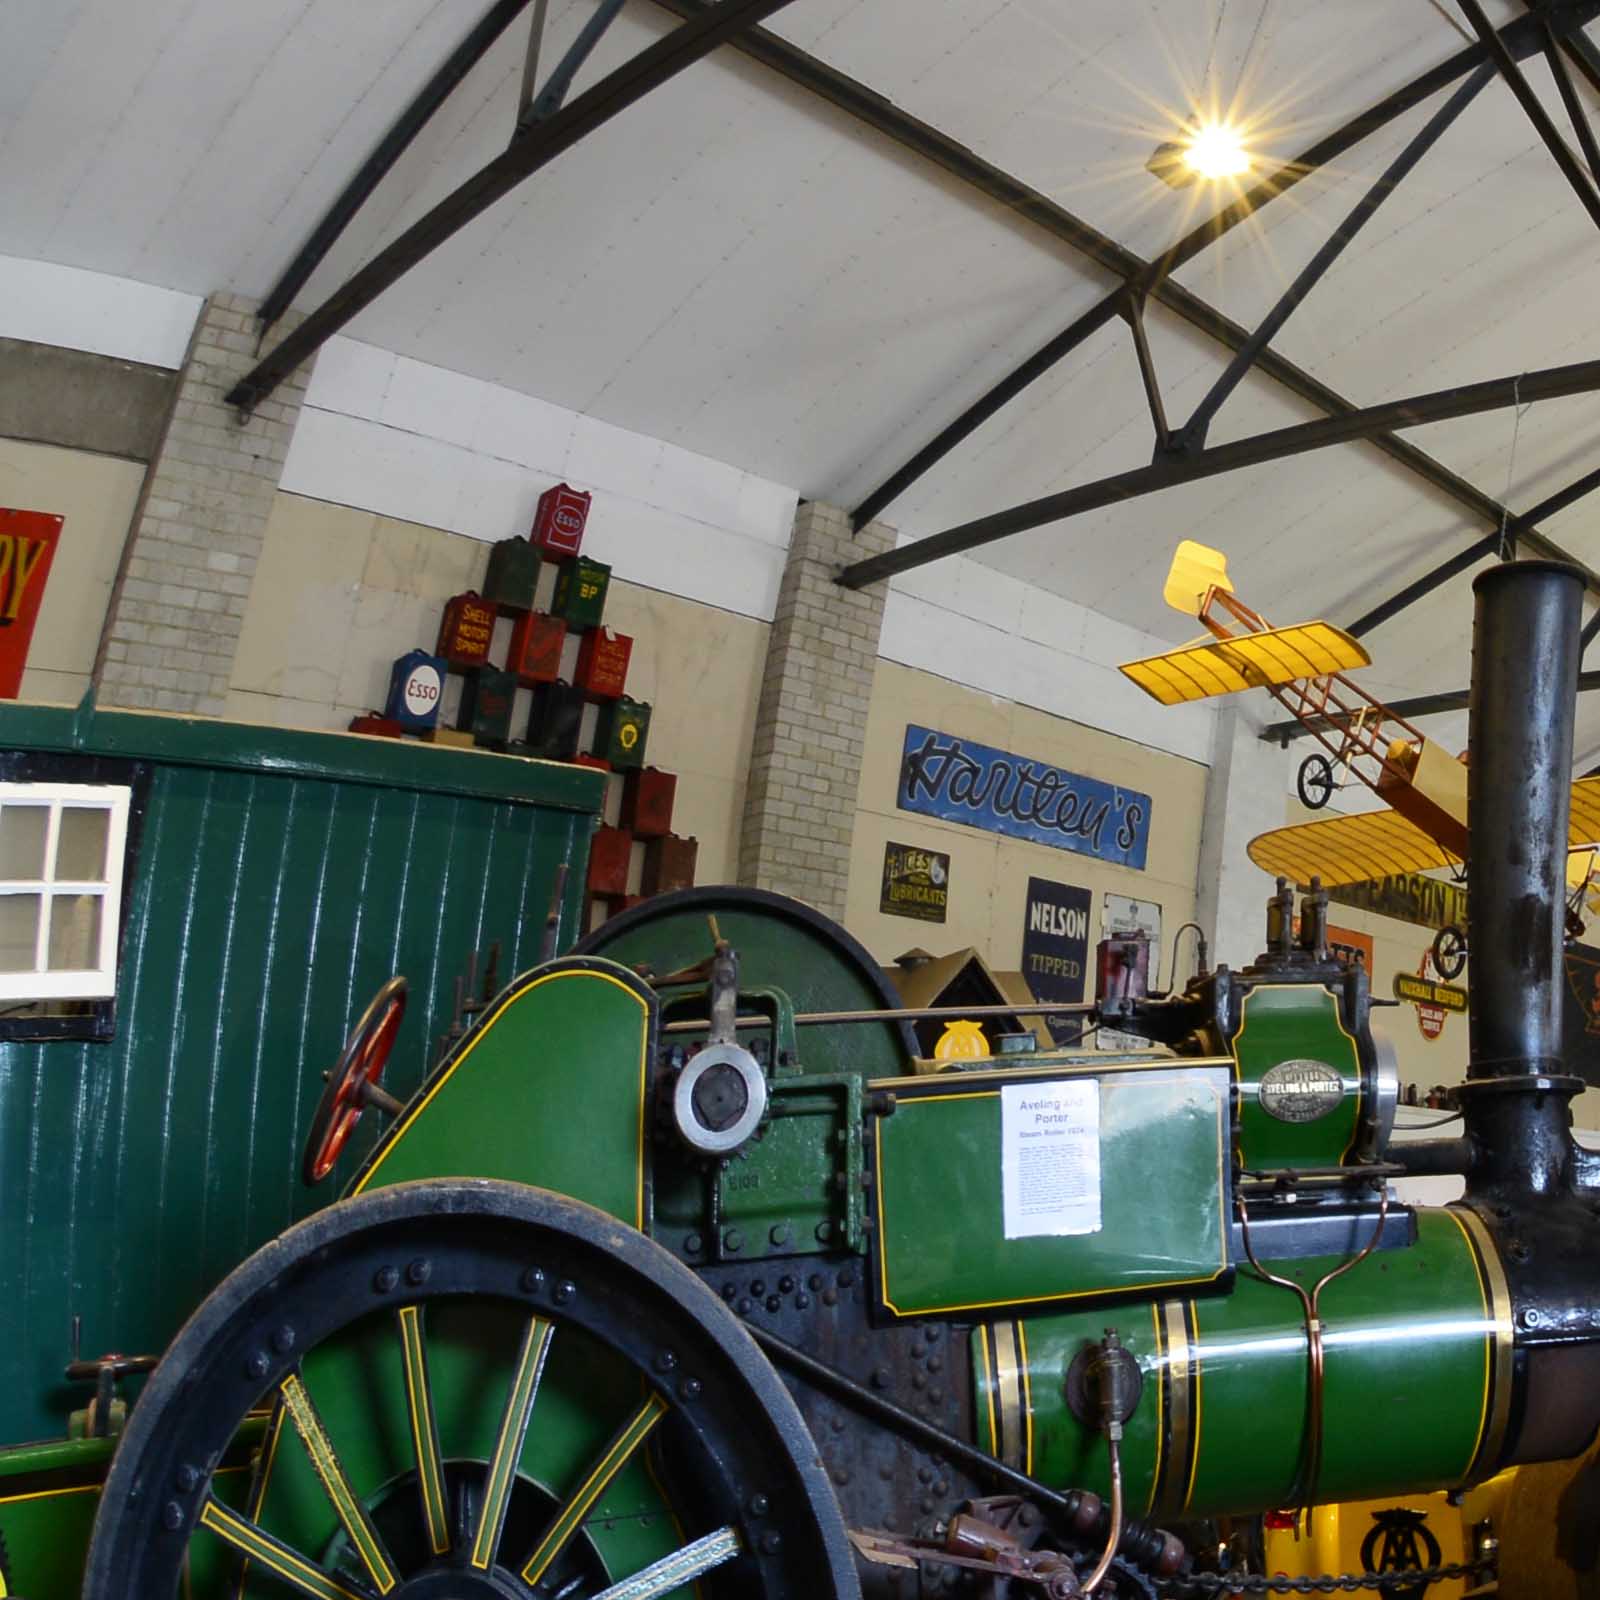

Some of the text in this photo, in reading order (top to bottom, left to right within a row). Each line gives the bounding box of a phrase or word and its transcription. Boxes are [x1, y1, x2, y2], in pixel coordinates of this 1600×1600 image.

[579, 584, 599, 599] BP
[463, 603, 491, 625] SHELL
[458, 622, 489, 641] MOTOR
[906, 733, 1142, 850] Hartley's
[1029, 901, 1088, 941] NELSON
[1029, 953, 1081, 979] TIPPED
[1019, 1099, 1061, 1113] Aveling
[1034, 1113, 1069, 1125] Porter
